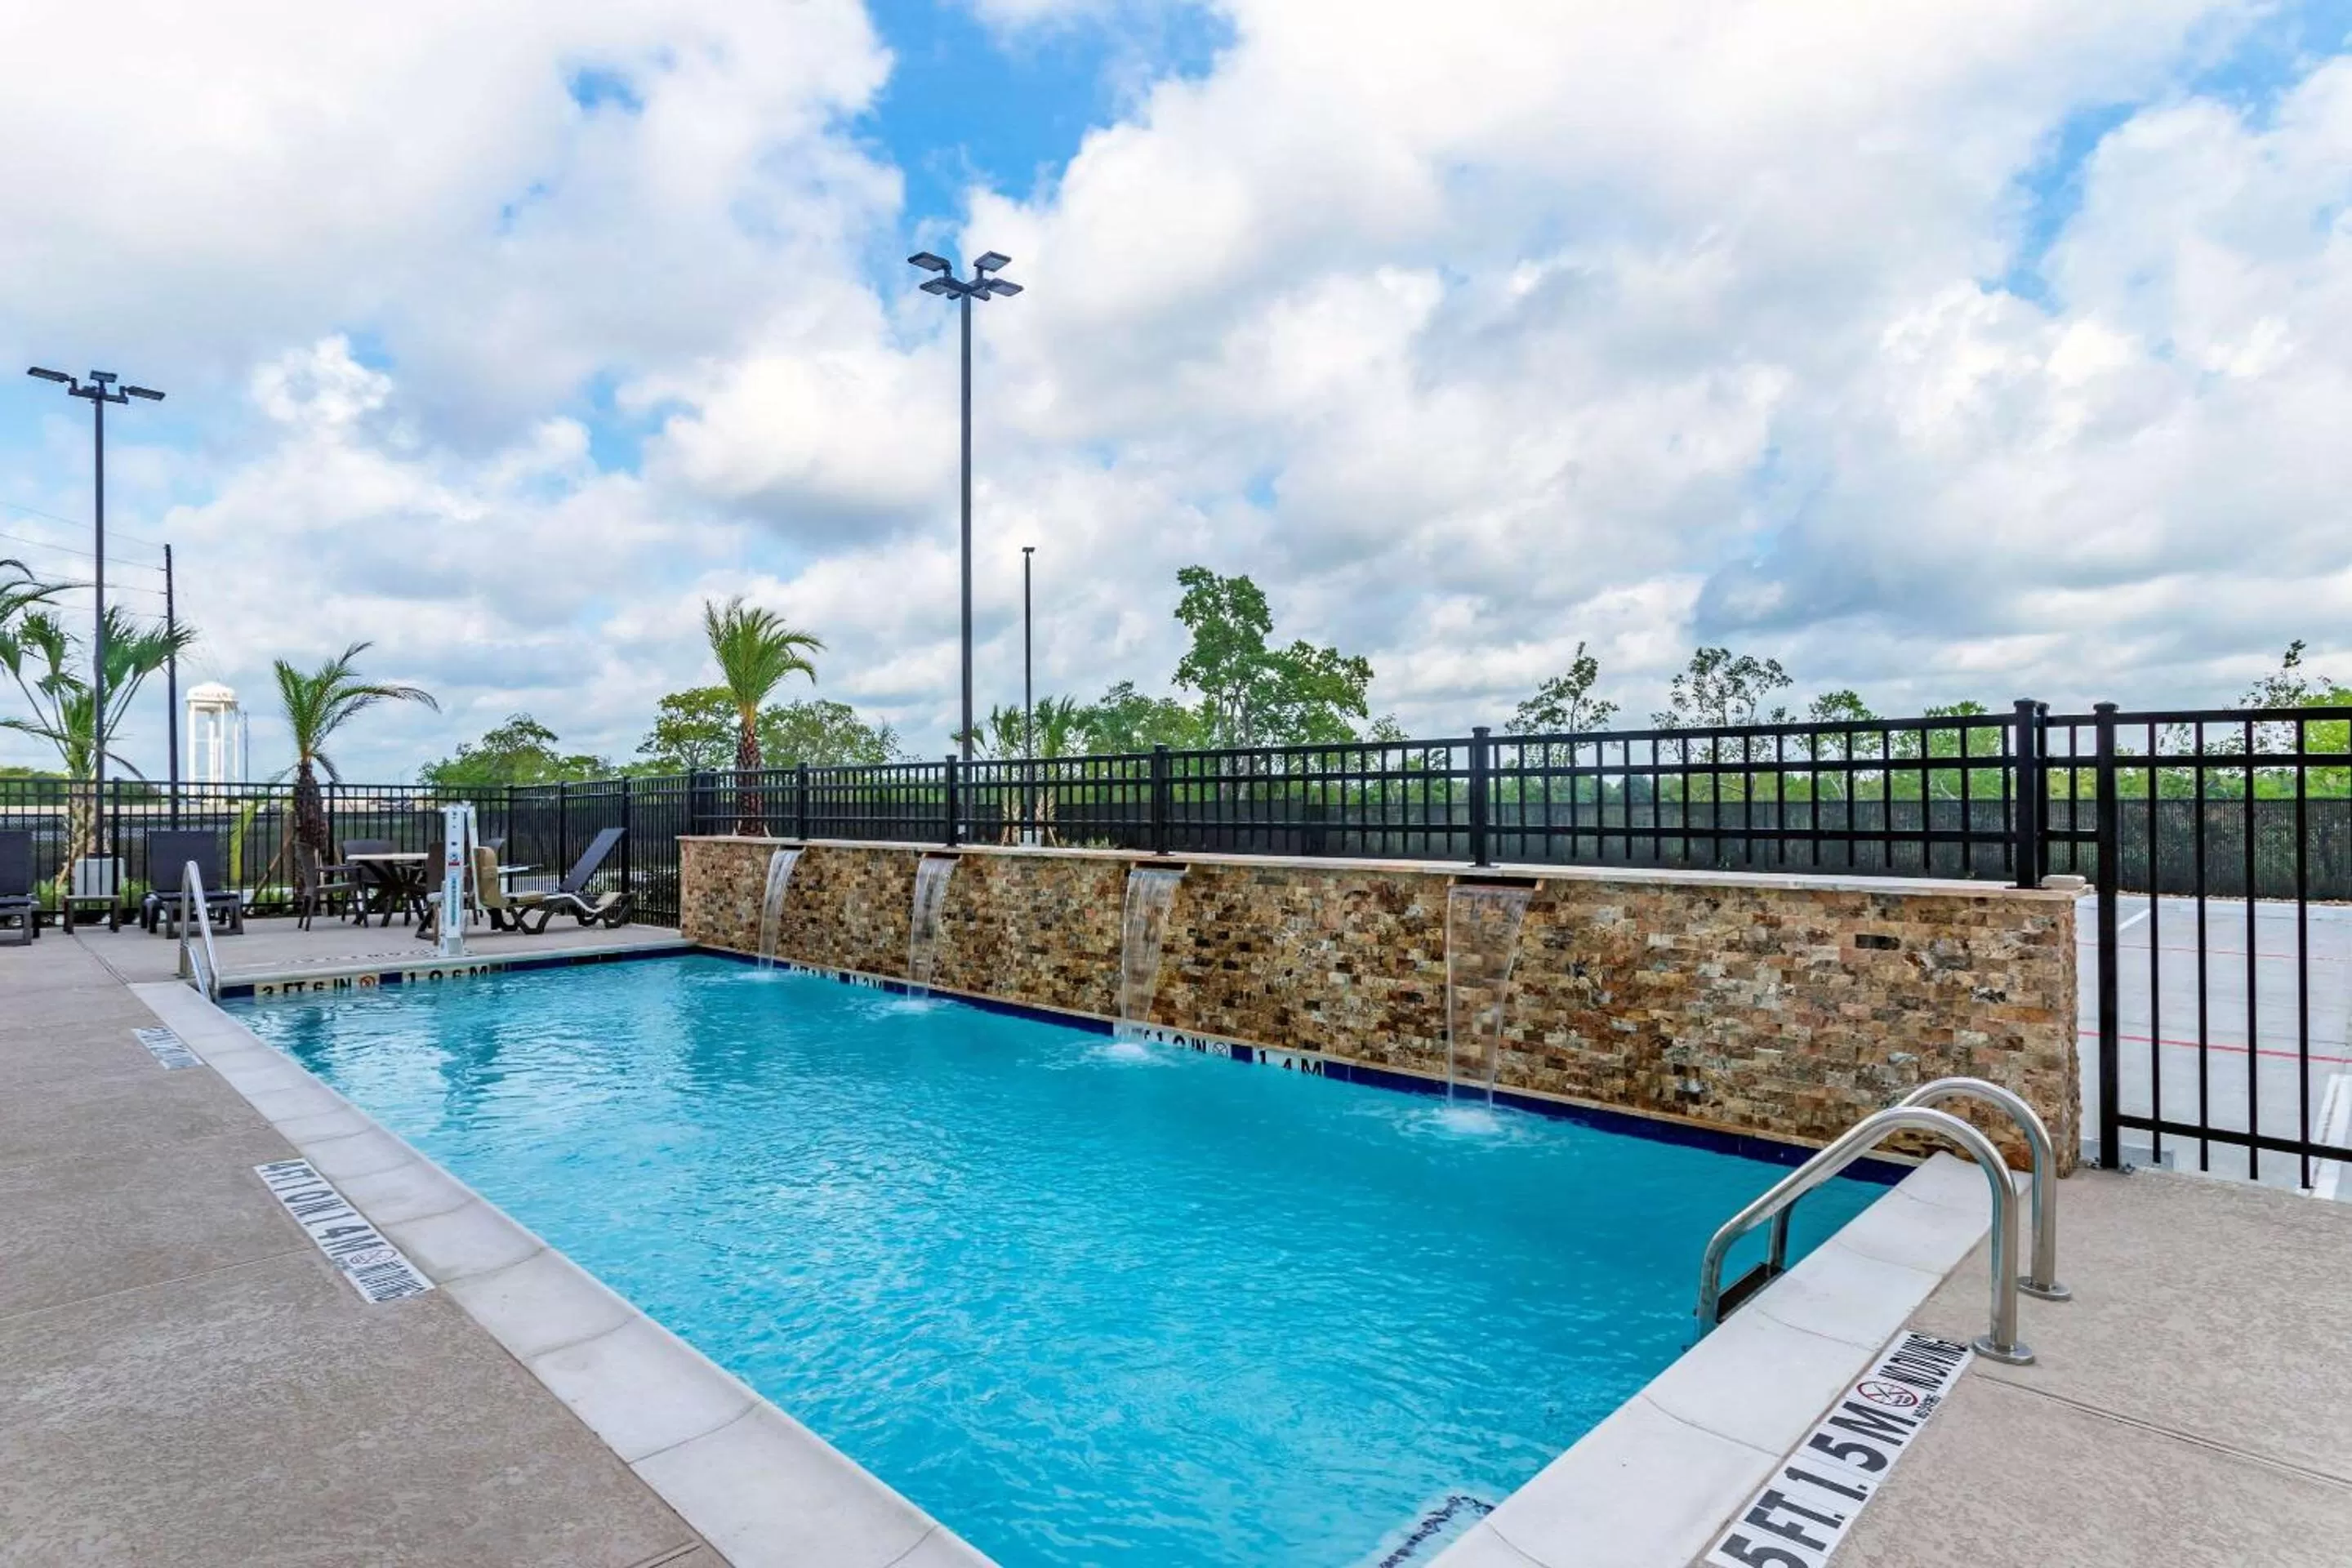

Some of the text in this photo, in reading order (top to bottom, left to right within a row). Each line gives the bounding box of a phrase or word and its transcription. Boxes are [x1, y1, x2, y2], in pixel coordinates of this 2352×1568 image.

[283, 981, 306, 994] FT
[333, 977, 352, 990] IN
[1191, 1036, 1207, 1054] IN
